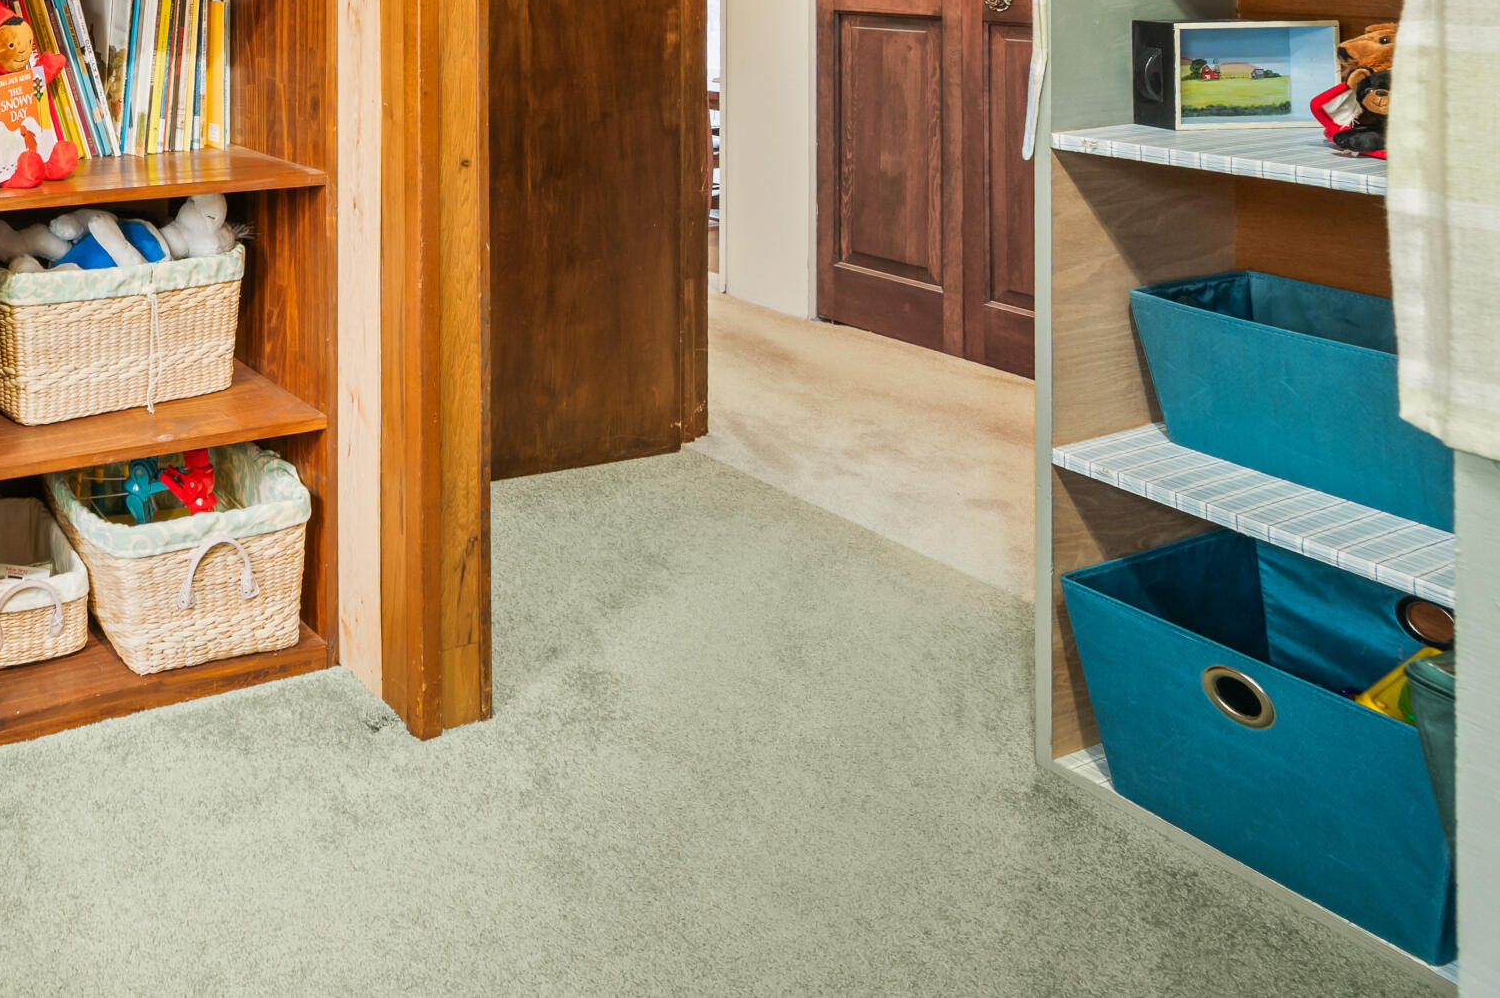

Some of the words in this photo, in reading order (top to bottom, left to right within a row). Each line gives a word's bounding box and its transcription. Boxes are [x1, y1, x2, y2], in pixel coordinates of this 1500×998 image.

[8, 86, 22, 98] THE
[0, 93, 35, 113] SNOWY
[10, 107, 28, 123] DAY
